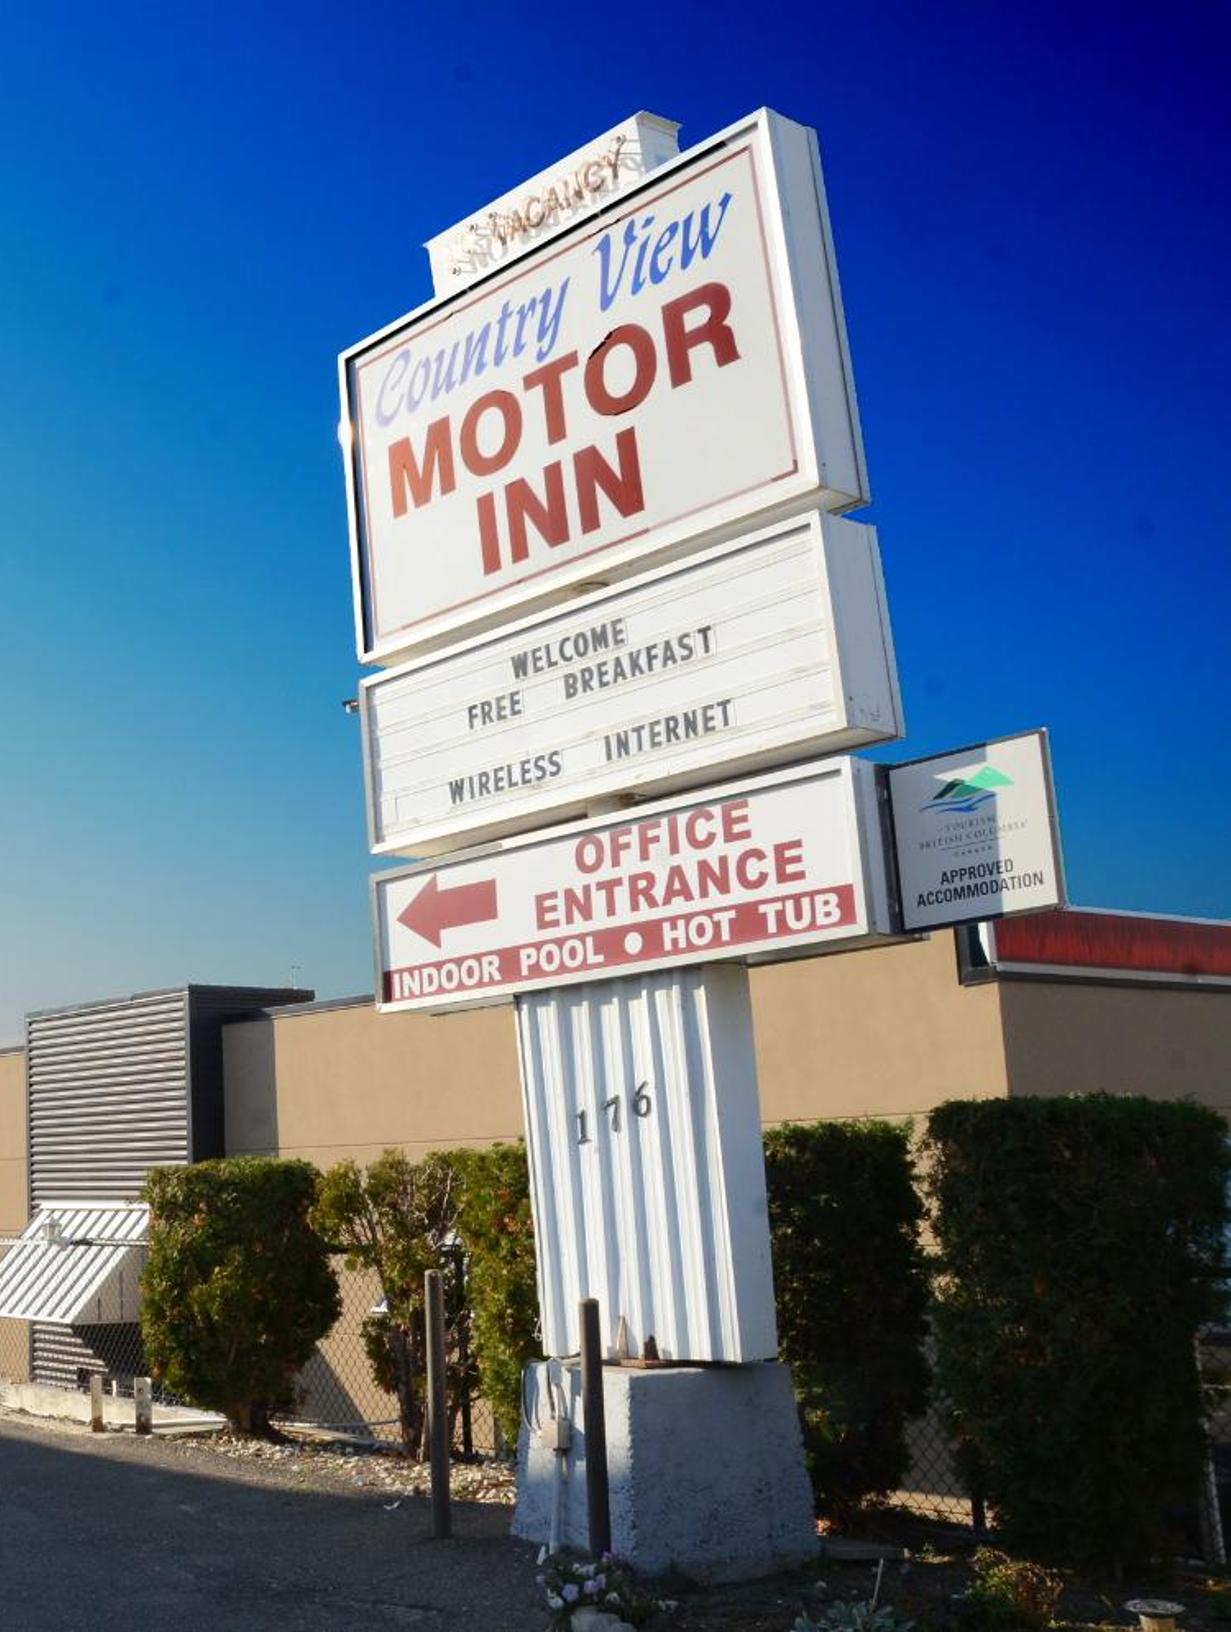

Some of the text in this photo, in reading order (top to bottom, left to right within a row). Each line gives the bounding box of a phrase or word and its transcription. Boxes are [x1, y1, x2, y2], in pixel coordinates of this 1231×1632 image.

[492, 135, 626, 248] VACANCY
[375, 191, 733, 428] Country View
[387, 282, 740, 519] MOTOR
[475, 426, 646, 576] INN
[467, 625, 713, 730] FREE BREAKFAST
[511, 618, 626, 680] WELCOME
[449, 698, 733, 805] WIRELESS INTERNET
[534, 839, 807, 931] ENTRANCE
[574, 799, 752, 875] OFFICE
[917, 871, 1044, 908] ACCOMMODATION
[940, 858, 1014, 886] APPROVED
[392, 891, 842, 999] INDOOR POOL HOT TUB
[575, 1080, 652, 1146] 176
